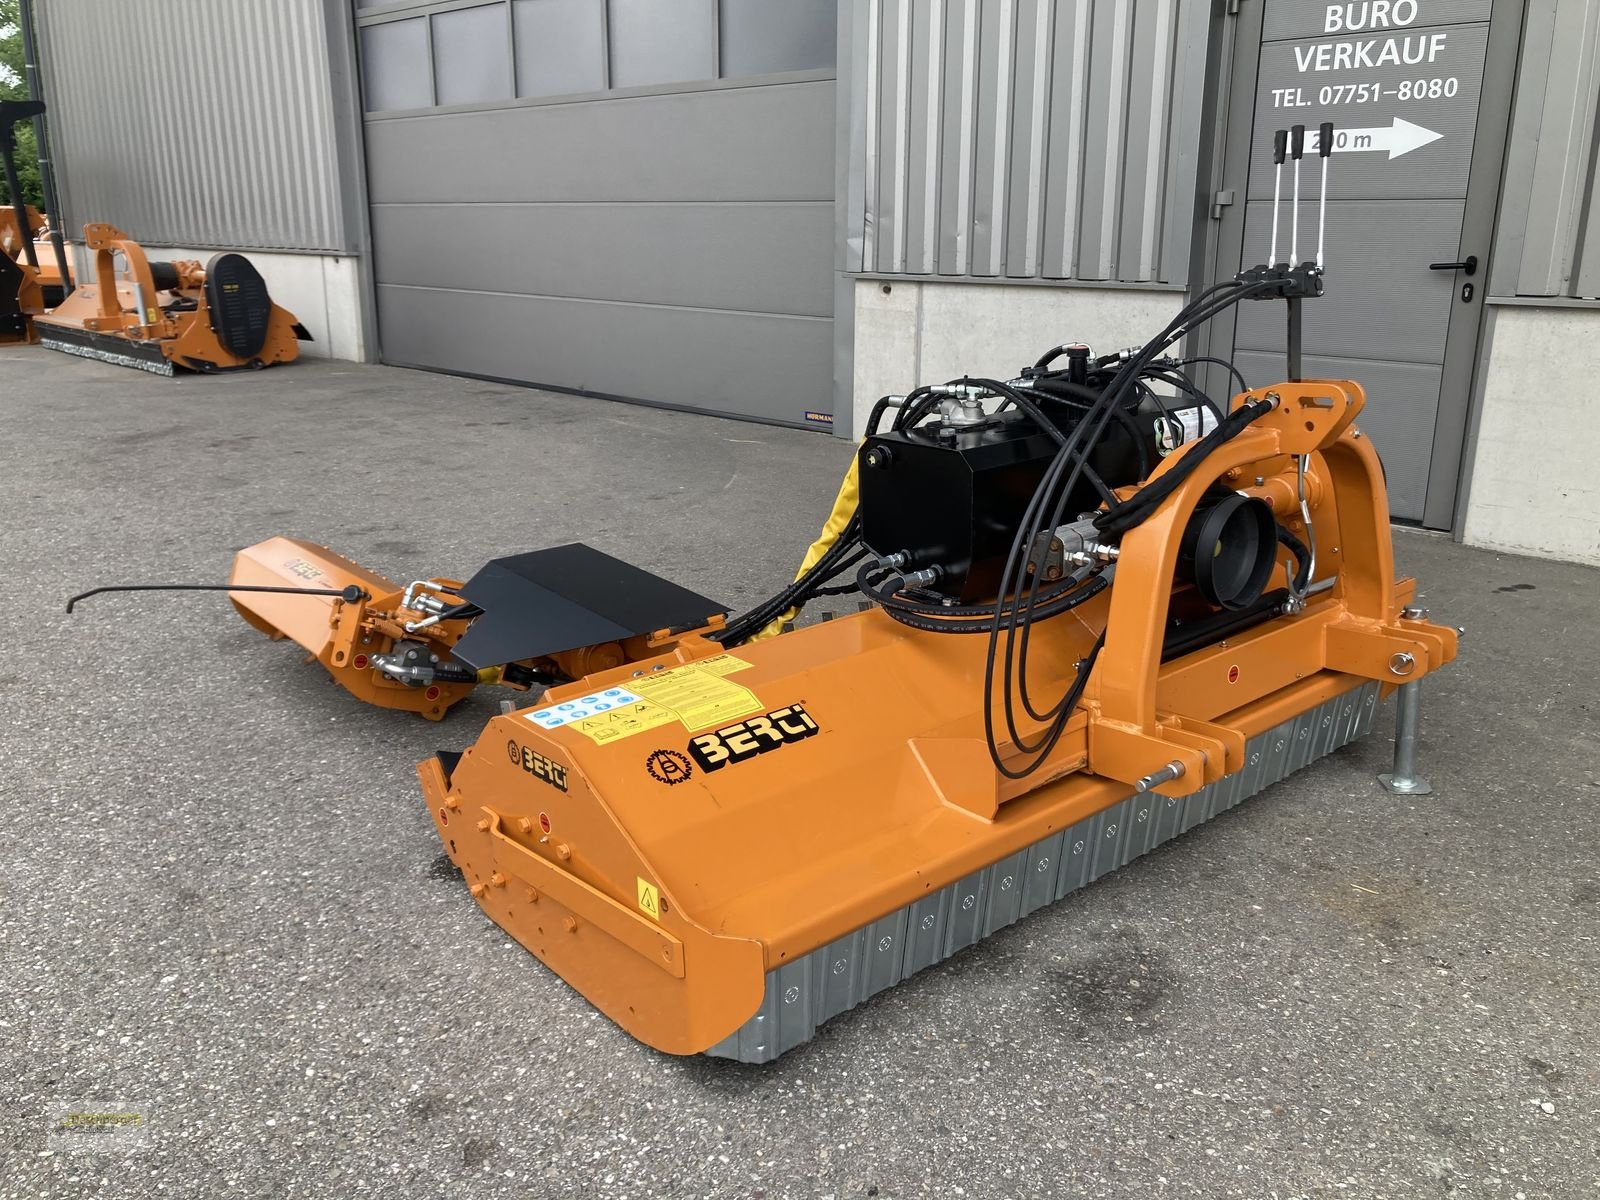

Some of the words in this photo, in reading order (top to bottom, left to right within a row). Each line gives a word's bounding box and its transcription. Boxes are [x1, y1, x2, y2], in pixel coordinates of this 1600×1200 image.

[1294, 34, 1447, 72] VERKAUF
[1272, 88, 1312, 107] TEL.
[1312, 132, 1347, 149] 20
[1354, 134, 1371, 148] m
